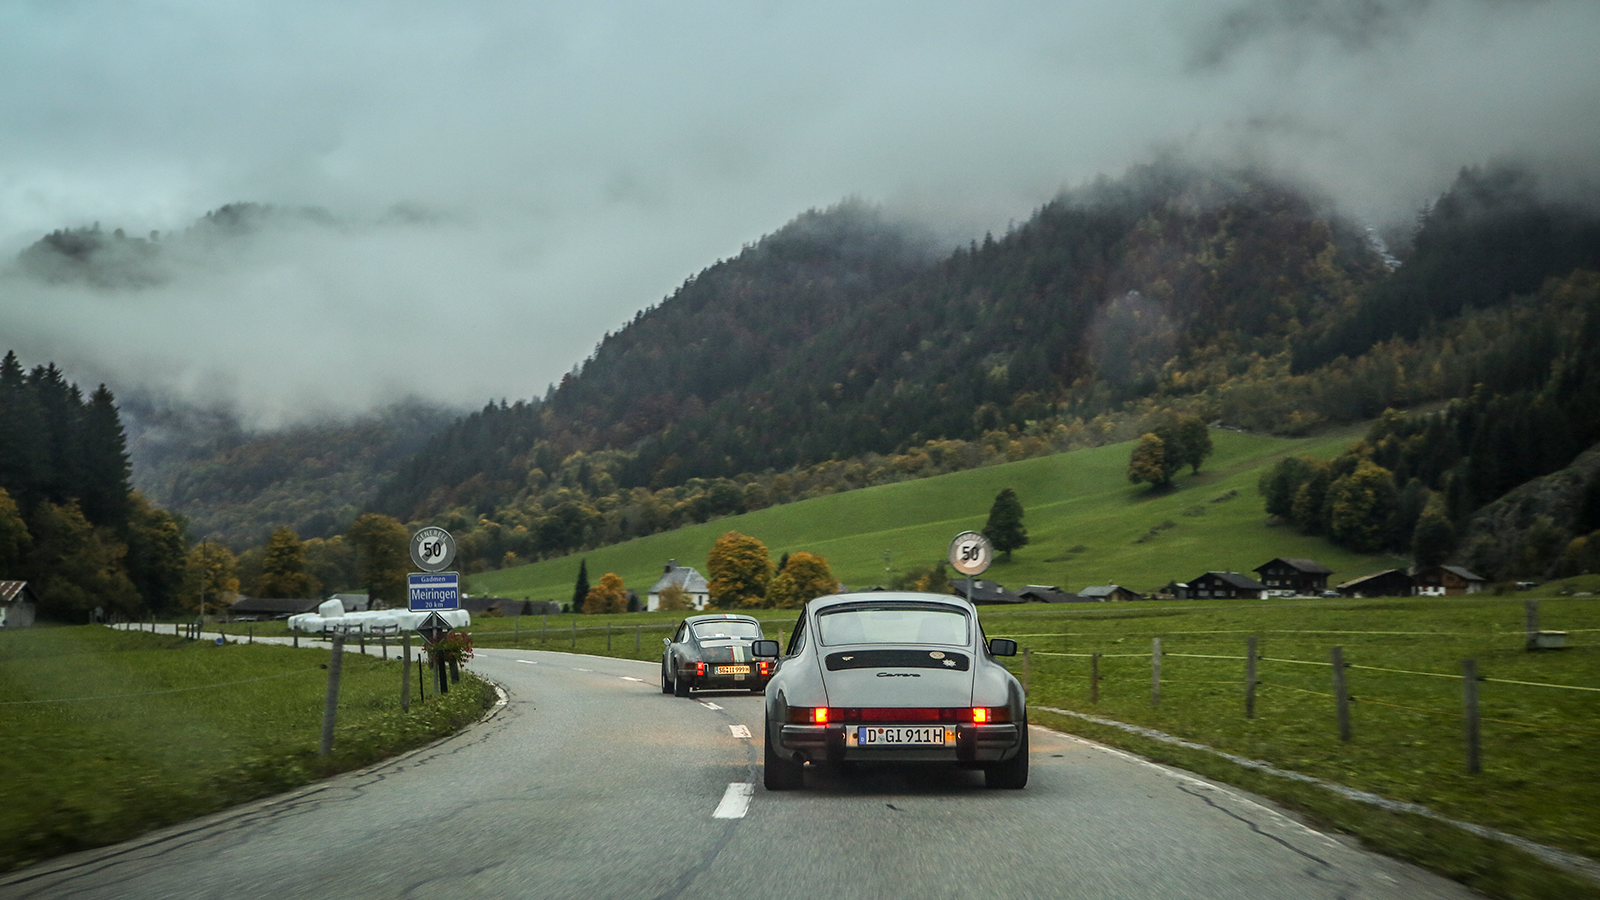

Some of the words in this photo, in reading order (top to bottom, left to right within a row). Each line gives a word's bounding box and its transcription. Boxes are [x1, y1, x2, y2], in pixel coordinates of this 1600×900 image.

[416, 529, 448, 542] GENERELL
[424, 542, 441, 557] 50
[962, 546, 979, 561] 50
[421, 575, 446, 583] Gadmen
[411, 588, 456, 602] Meiringen
[867, 729, 877, 743] D
[886, 729, 903, 743] GI
[905, 729, 943, 743] 911H
